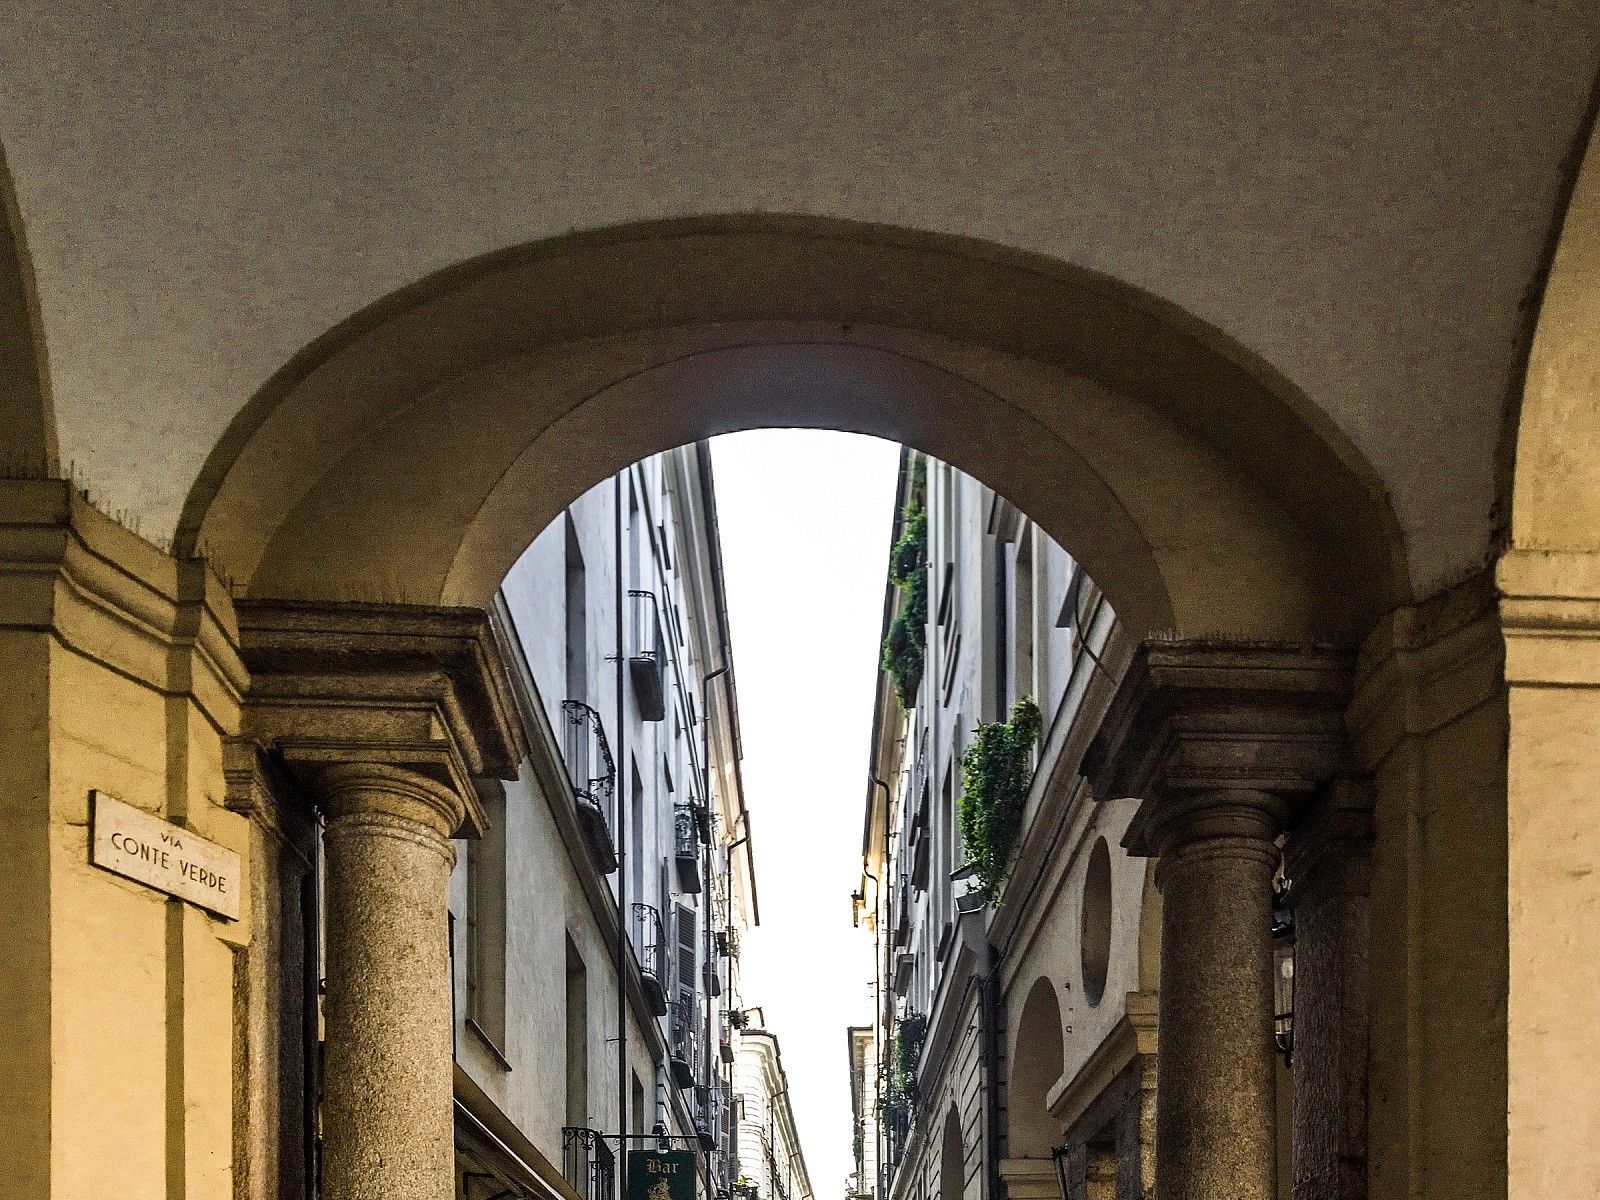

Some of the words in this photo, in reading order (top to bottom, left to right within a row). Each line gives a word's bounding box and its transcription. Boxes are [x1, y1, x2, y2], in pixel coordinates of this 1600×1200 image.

[160, 832, 183, 849] VIA
[111, 832, 170, 870] CONTE
[179, 859, 226, 894] VERDE
[646, 1158, 680, 1174] Bar
